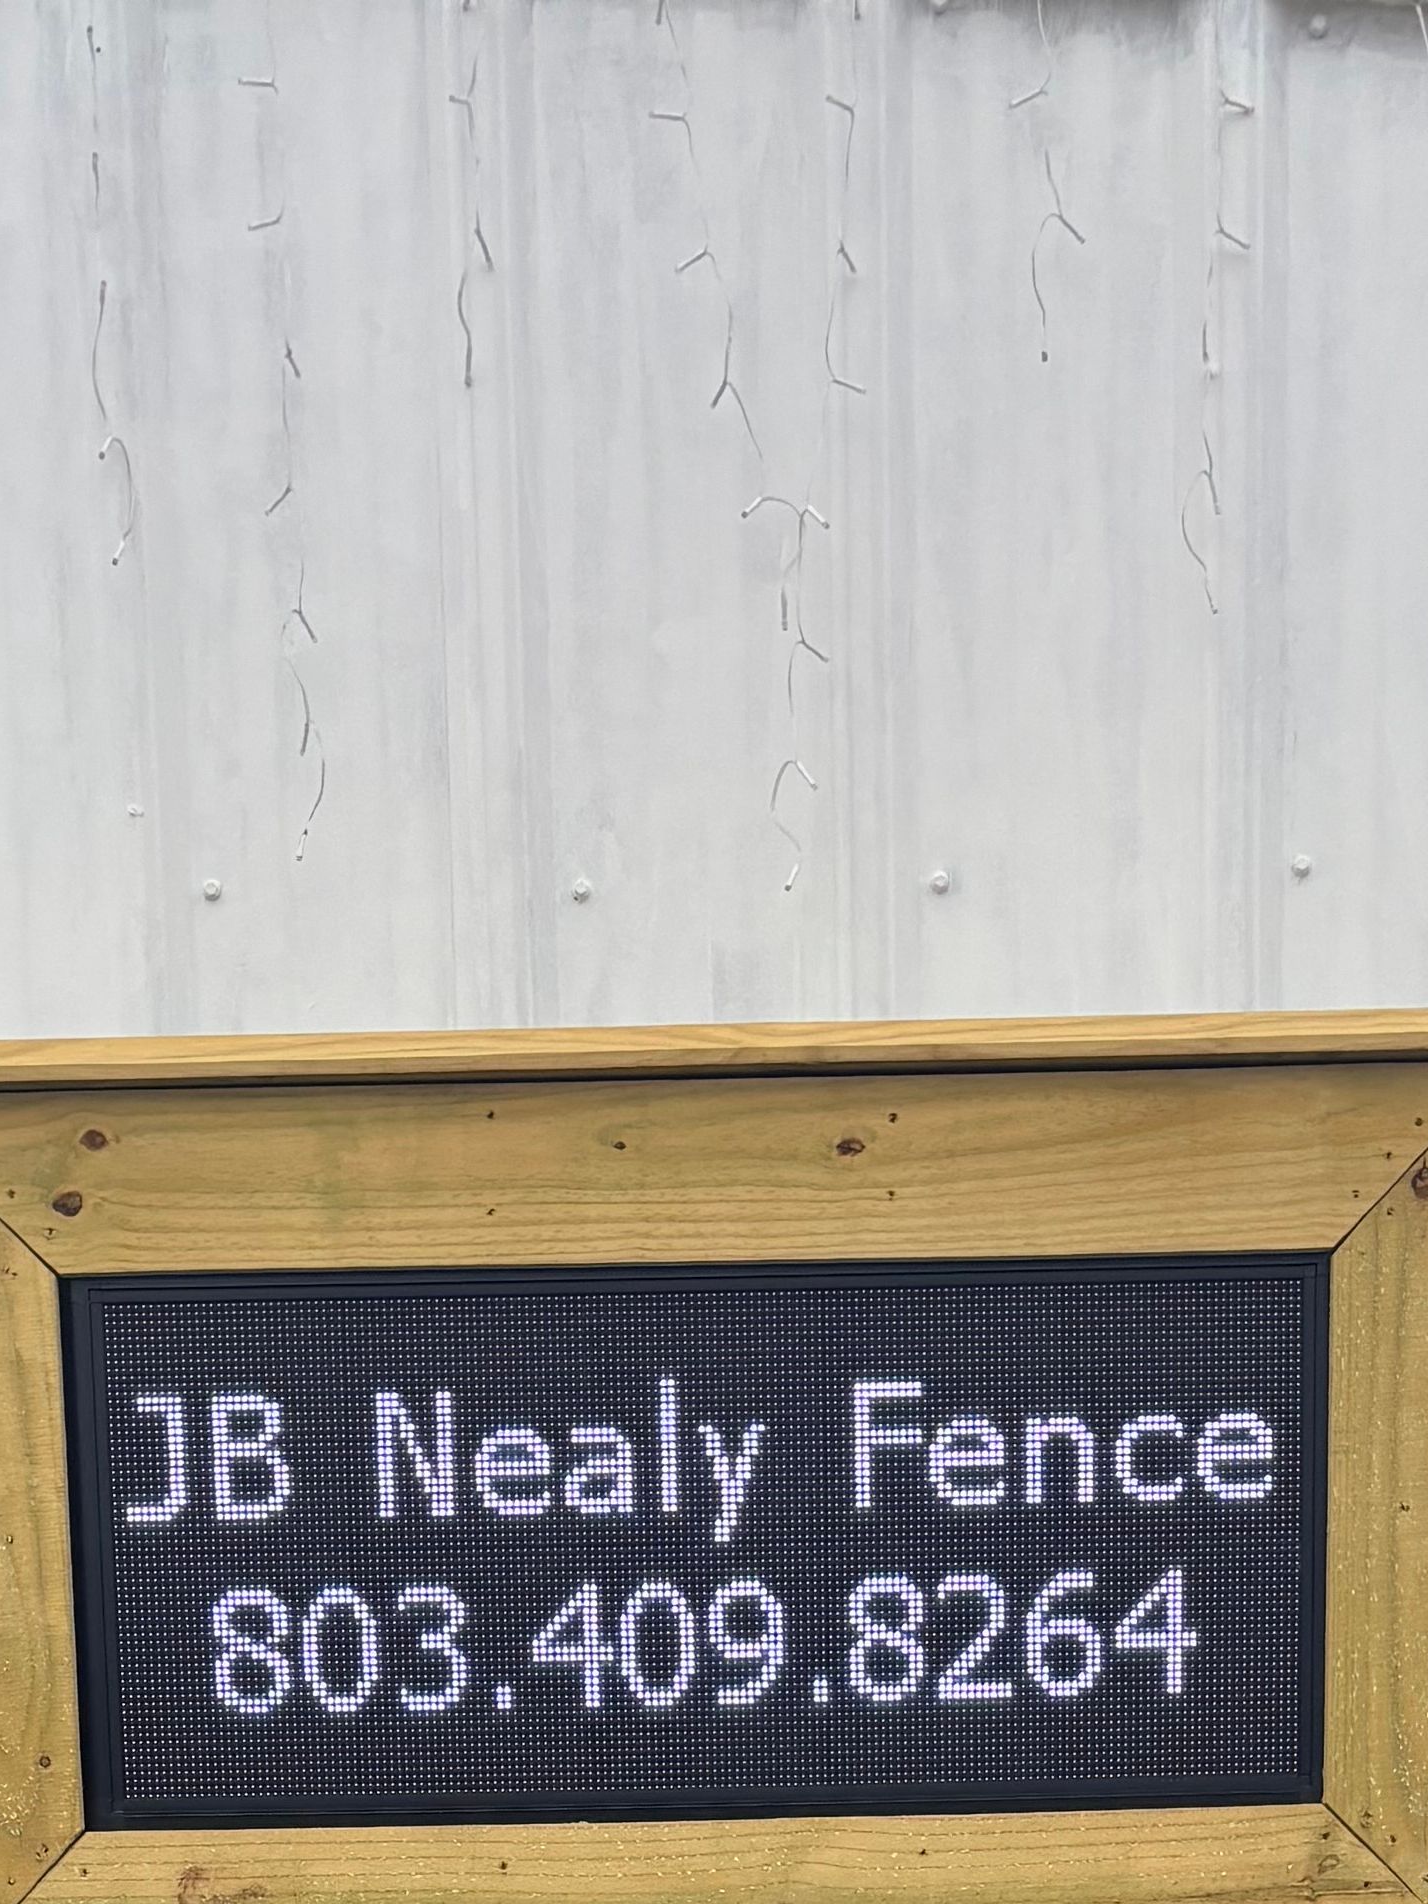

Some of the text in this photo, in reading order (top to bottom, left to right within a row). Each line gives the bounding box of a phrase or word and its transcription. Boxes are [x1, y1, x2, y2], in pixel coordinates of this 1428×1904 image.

[123, 1376, 1277, 1546] JB Nealy Fence
[209, 1565, 1200, 1716] 803.409.8264
